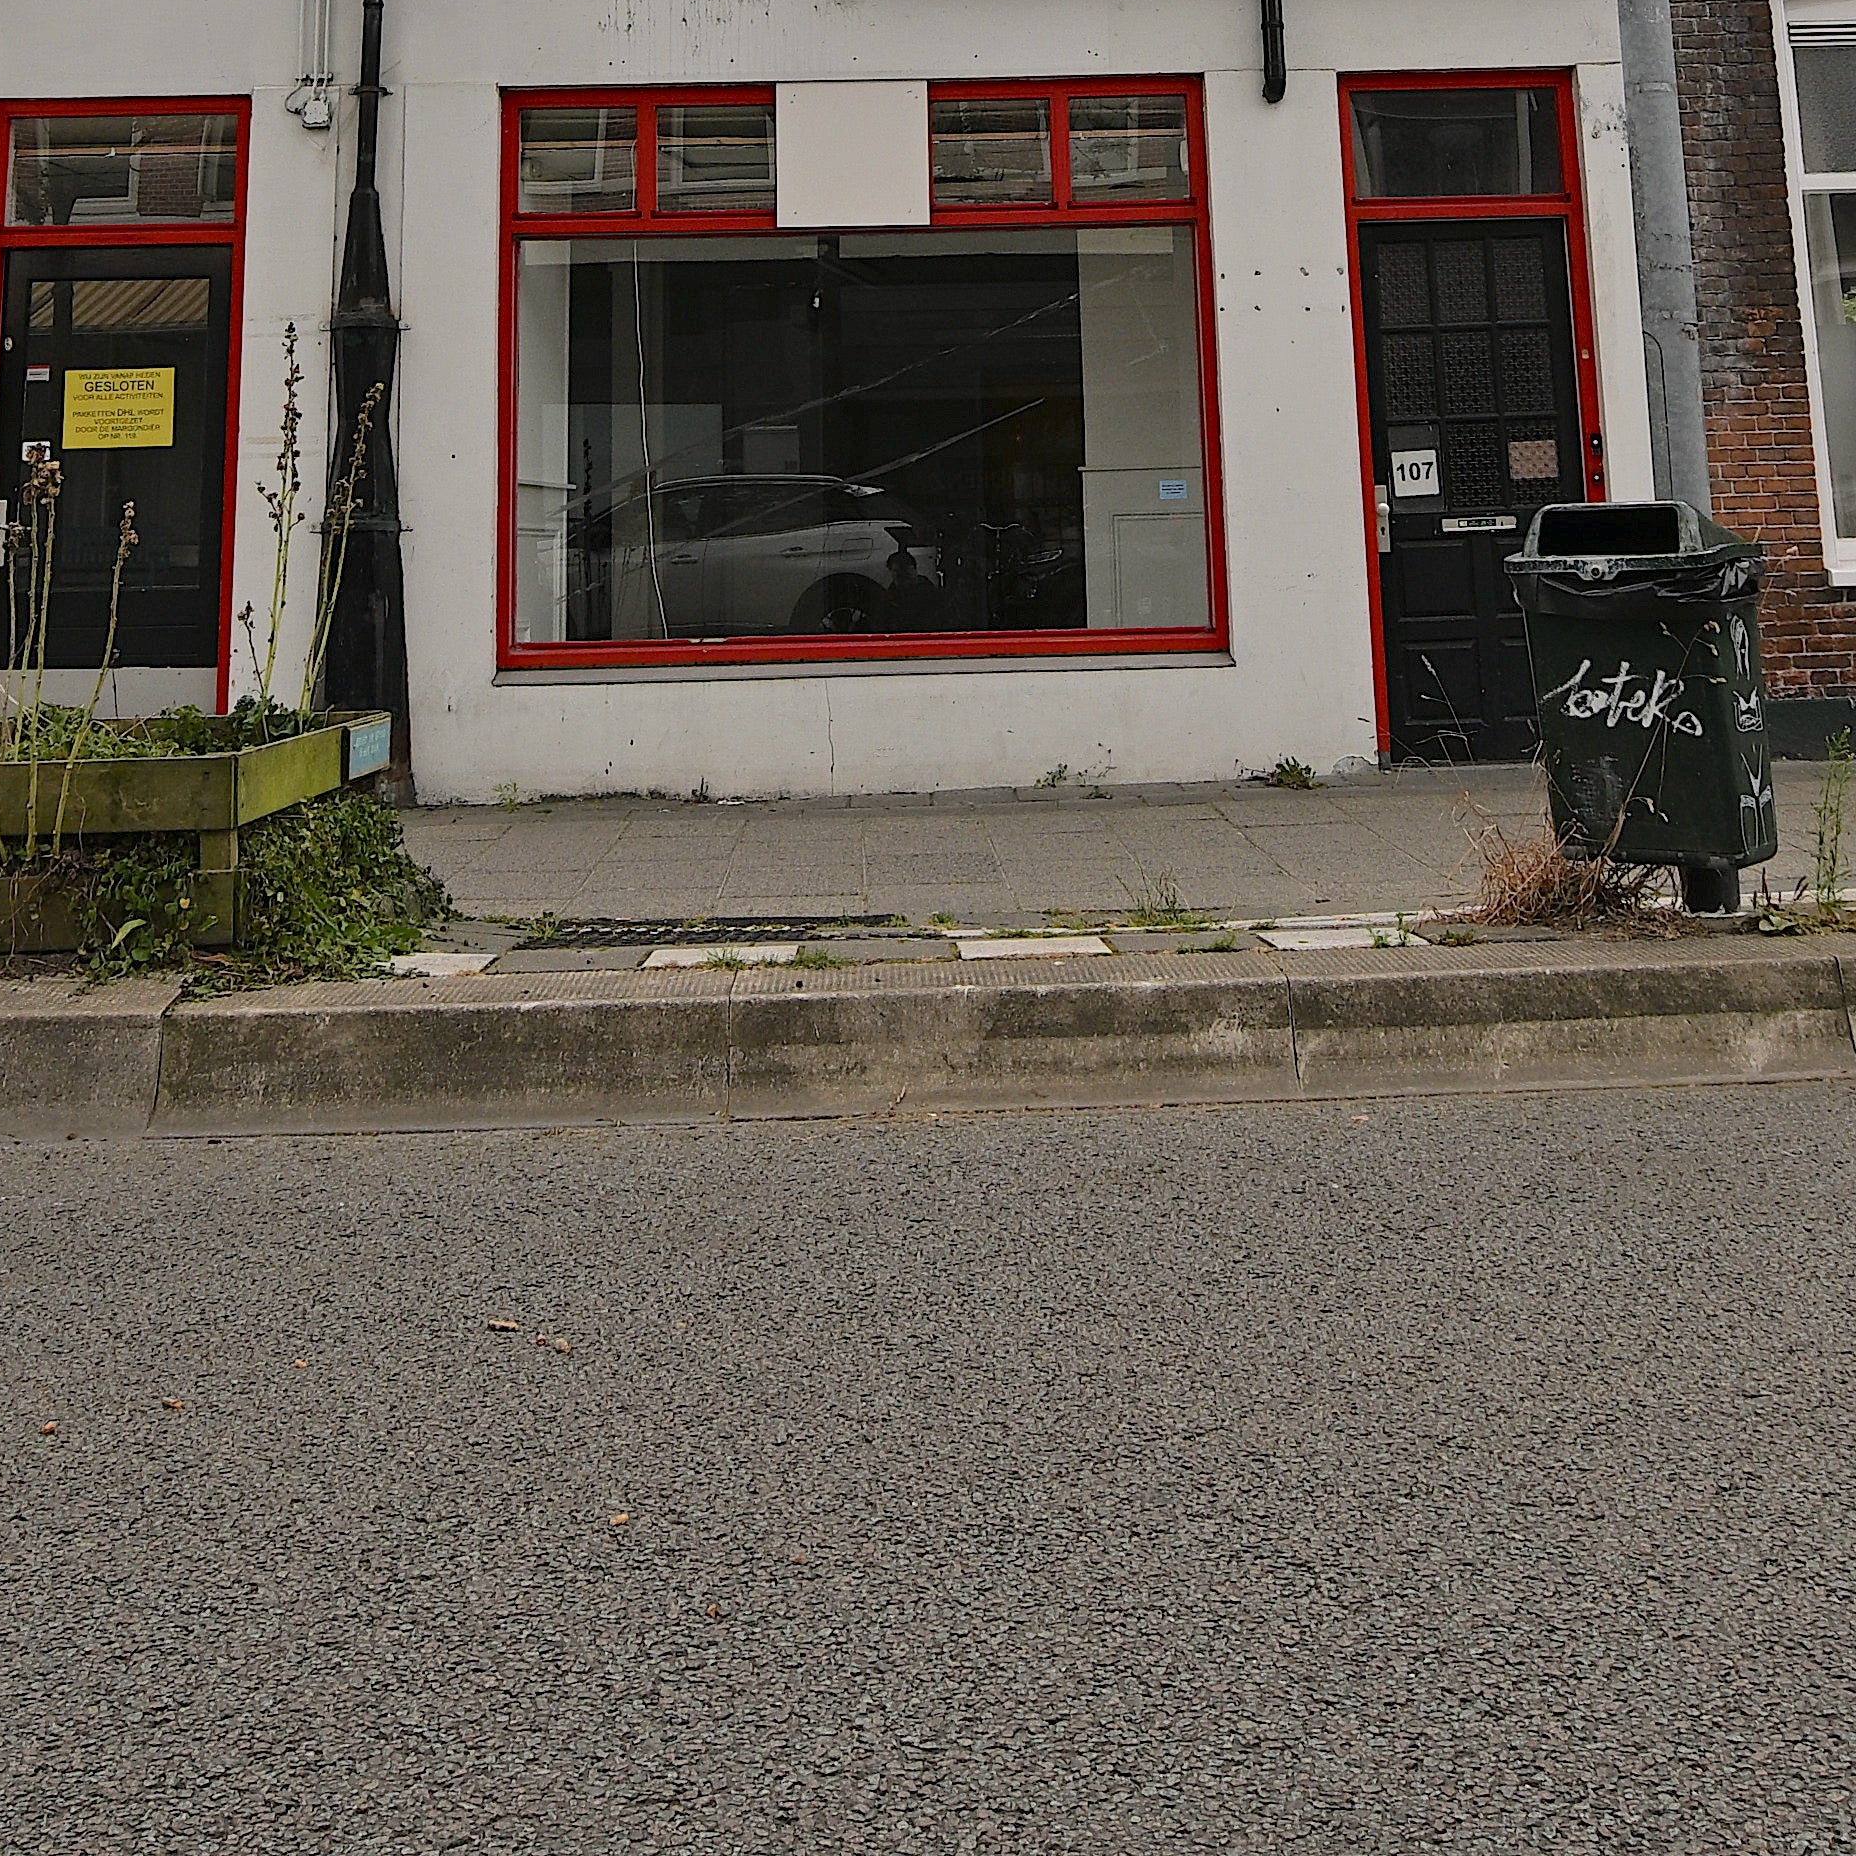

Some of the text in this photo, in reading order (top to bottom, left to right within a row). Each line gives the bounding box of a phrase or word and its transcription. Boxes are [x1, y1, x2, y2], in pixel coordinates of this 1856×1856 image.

[84, 380, 155, 393] GESLOTEN
[73, 393, 95, 401] VOOR
[1396, 462, 1434, 482] 107
